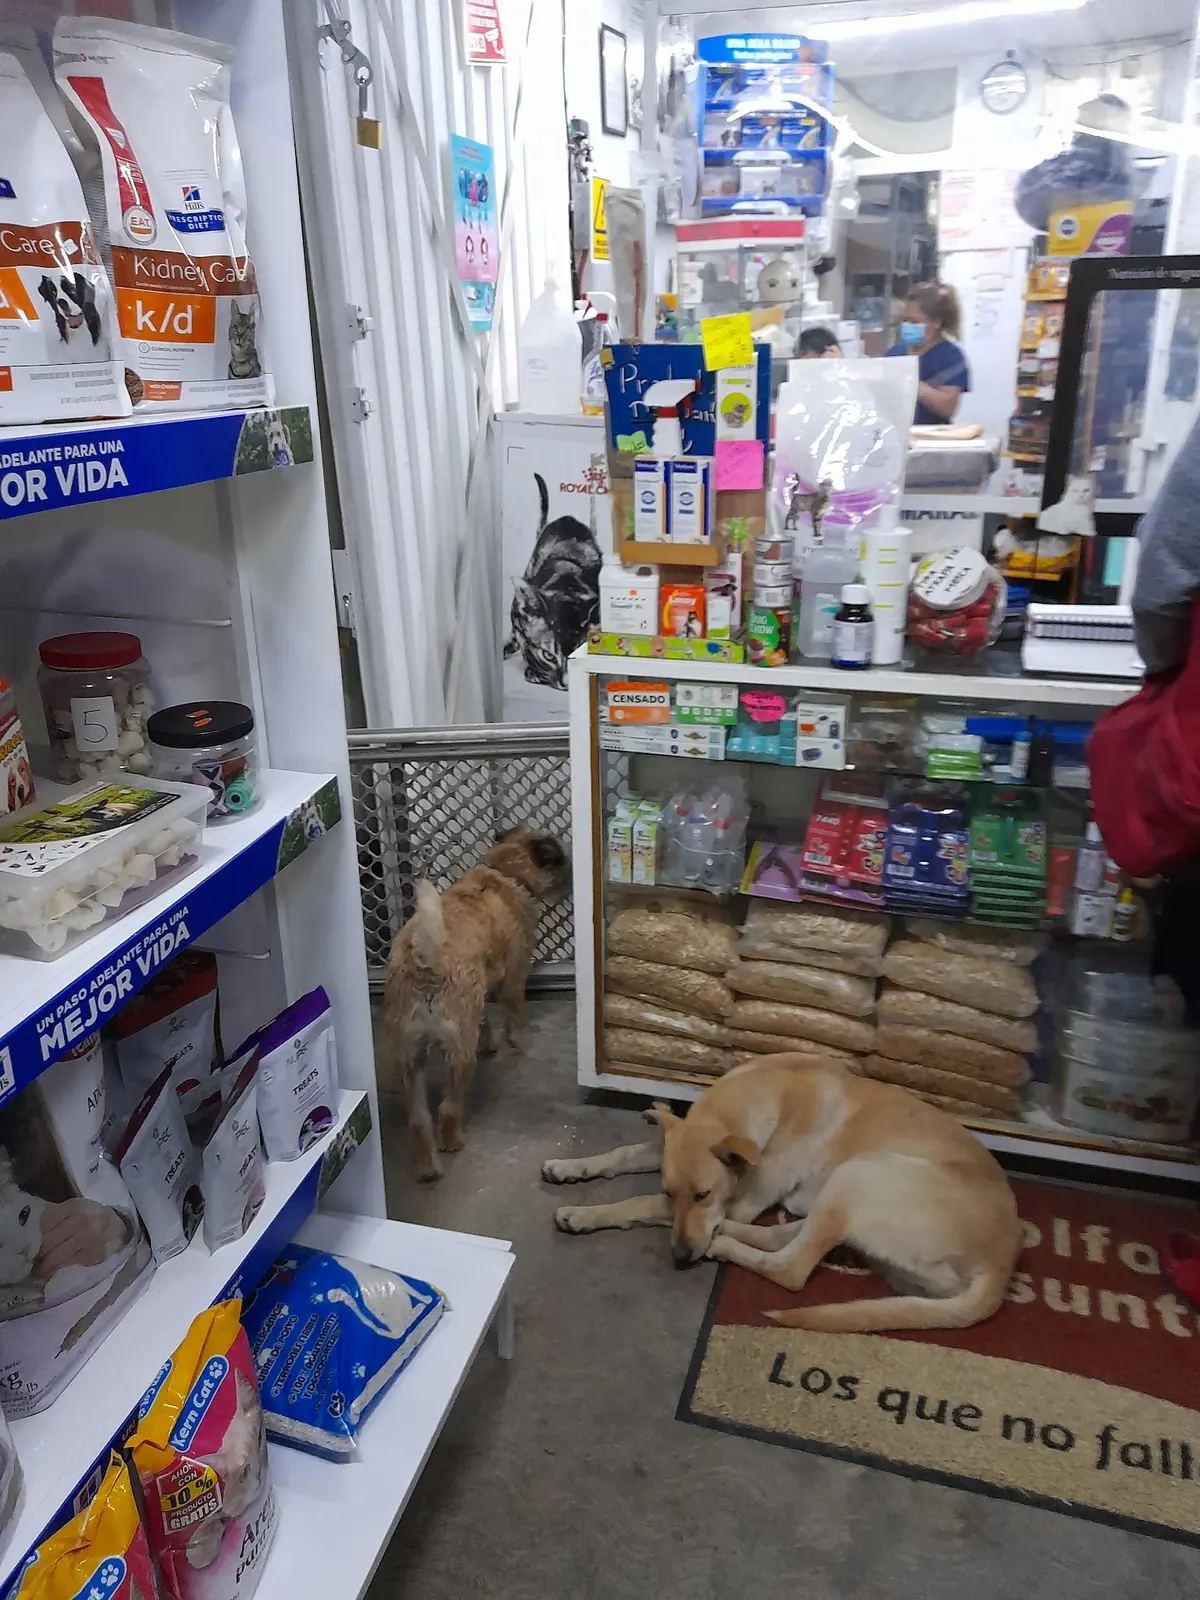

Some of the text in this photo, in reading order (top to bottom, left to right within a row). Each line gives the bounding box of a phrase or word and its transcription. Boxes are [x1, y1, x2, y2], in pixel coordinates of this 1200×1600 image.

[130, 216, 150, 227] EAT
[168, 212, 225, 225] PRESCRIPTIO
[188, 222, 209, 230] DIET
[1, 230, 54, 255] Care
[134, 255, 205, 287] Kidney
[136, 300, 193, 334] k/d
[64, 443, 97, 459] PARA
[99, 439, 125, 454] UNA
[54, 457, 129, 496] VIDA
[560, 482, 593, 494] ROYAL
[613, 694, 666, 704] CENSADO
[83, 709, 108, 743] 5
[36, 906, 190, 1034] UN PASO ADELANTE PARA UNA
[39, 921, 190, 1062] MEJOR VIDA
[293, 1068, 320, 1096] TREATS
[165, 1150, 186, 1184] TREATS
[239, 1144, 258, 1178] TREAT
[1005, 1271, 1200, 1338] sunt
[275, 1343, 303, 1389] TERRONES
[171, 1378, 216, 1448] Kern Cat
[769, 1352, 1200, 1481] Los que no fall
[170, 1462, 193, 1482] AHOR
[178, 1471, 198, 1487] CON
[167, 1474, 214, 1508] 10 %
[170, 1492, 213, 1517] PRODUCTO
[170, 1498, 217, 1531] GRATIS
